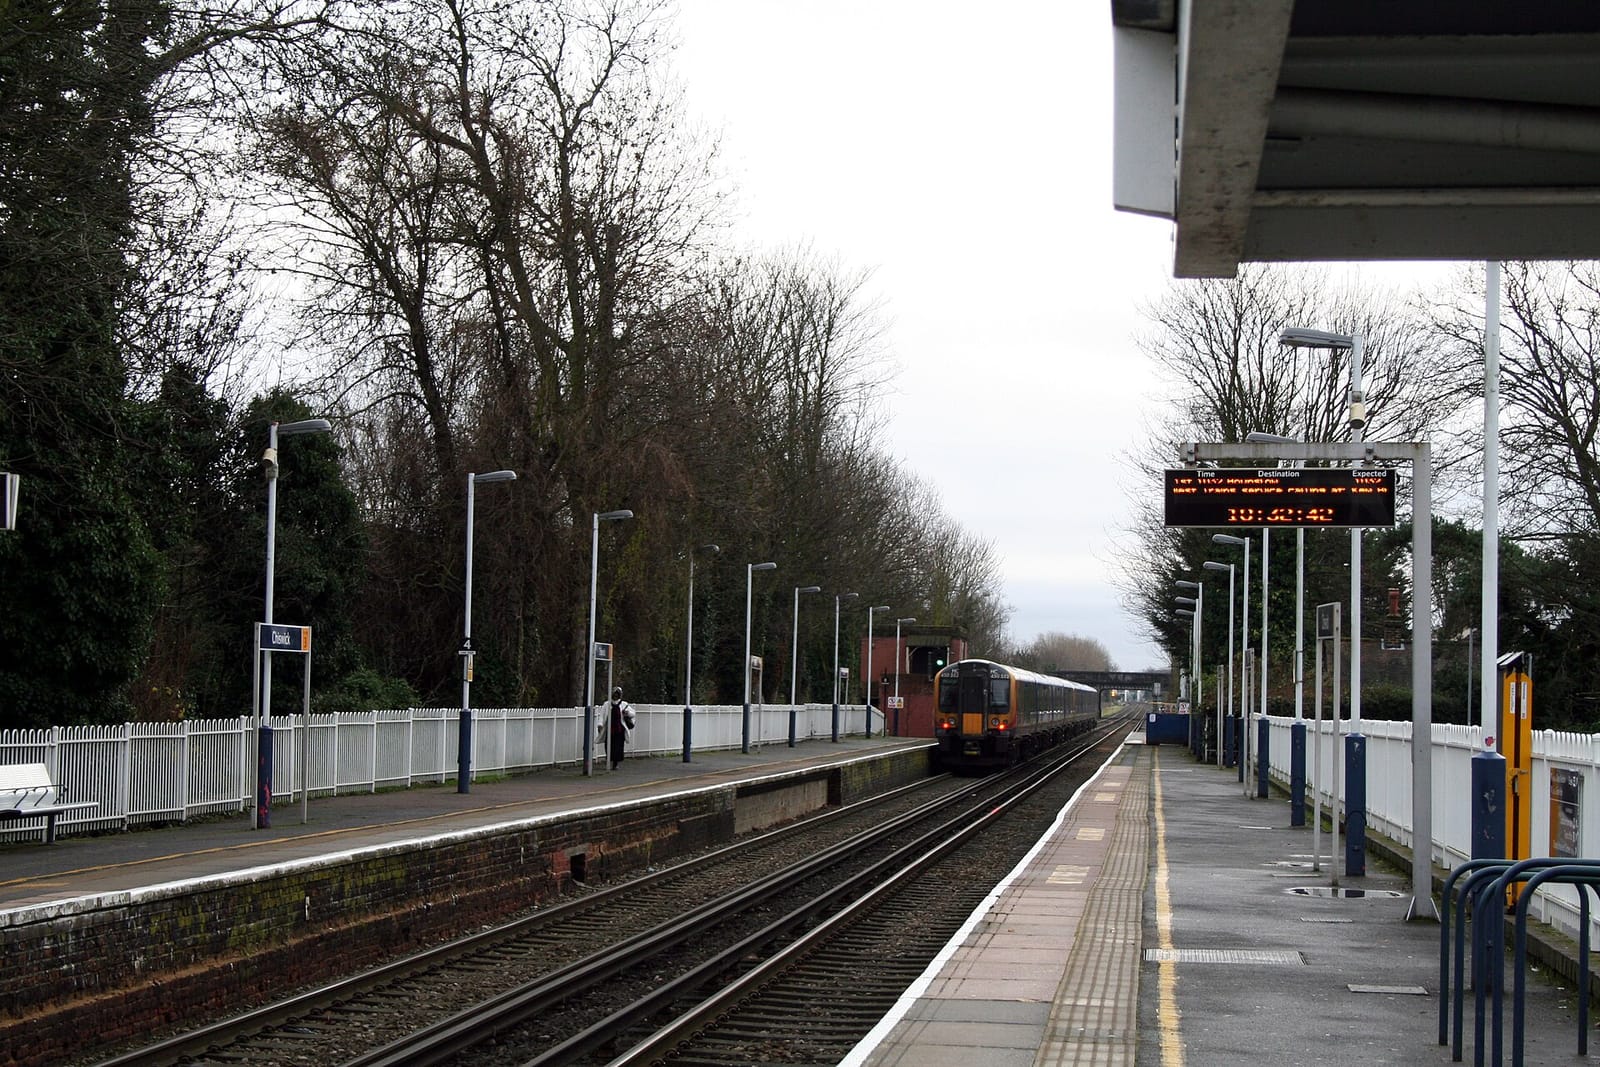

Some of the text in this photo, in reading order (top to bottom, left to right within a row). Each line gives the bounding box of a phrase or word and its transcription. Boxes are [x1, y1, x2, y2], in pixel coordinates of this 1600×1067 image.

[1197, 470, 1387, 479] Time Destination Expected
[1227, 507, 1334, 522] 10:32:42
[463, 639, 472, 650] 4
